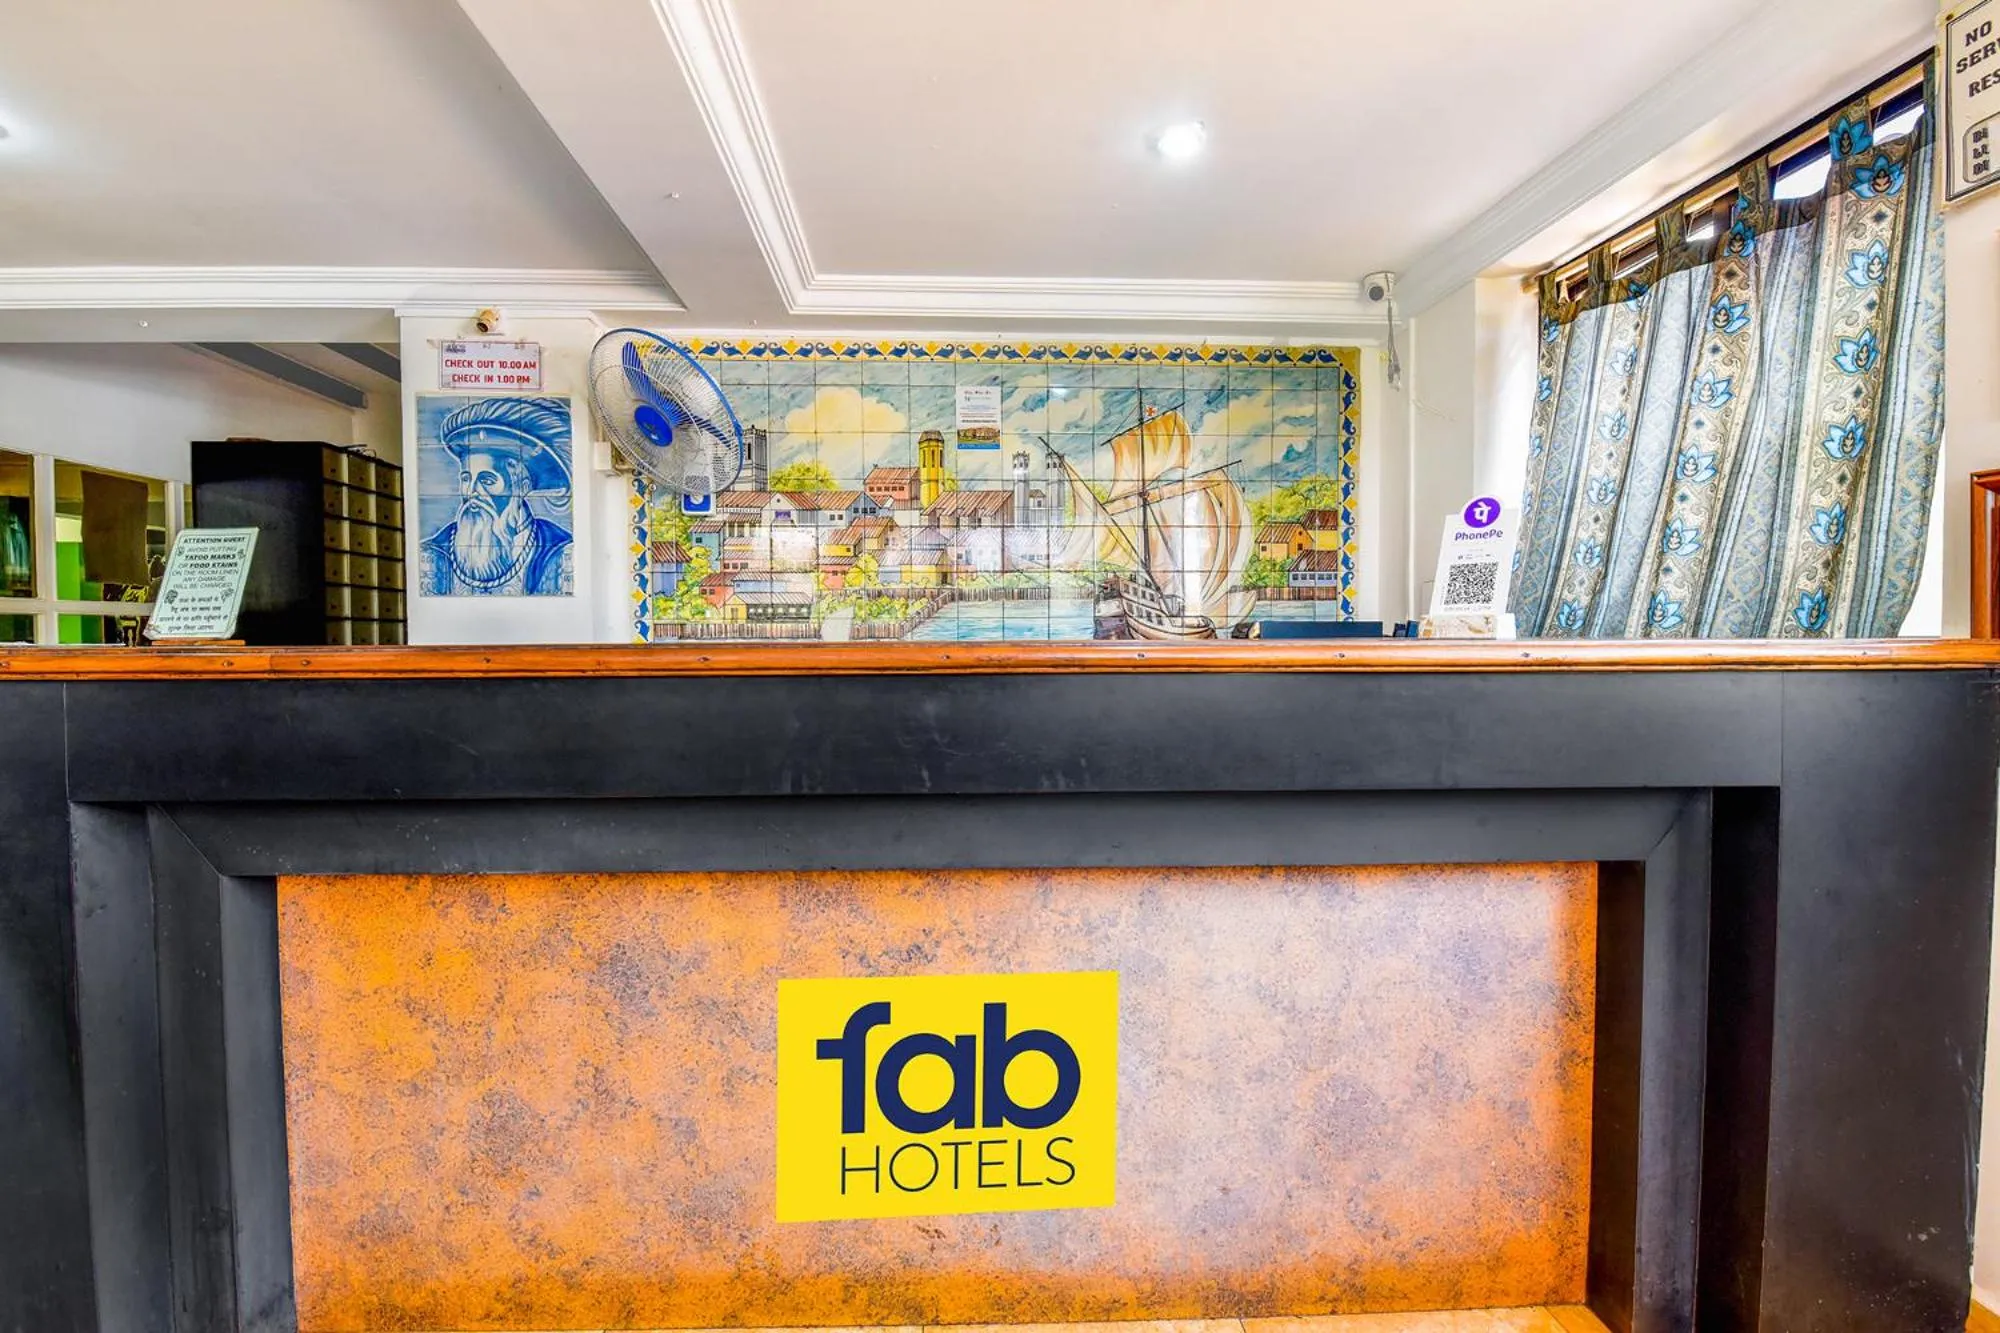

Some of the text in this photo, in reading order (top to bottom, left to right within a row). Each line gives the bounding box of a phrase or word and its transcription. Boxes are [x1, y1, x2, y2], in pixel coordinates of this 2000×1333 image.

[1965, 20, 1992, 47] NO
[1956, 37, 2000, 74] SER
[444, 359, 537, 370] CHECK OUT 10.00 AM
[452, 374, 531, 384] CHECK IN 1.00 PM
[1455, 529, 1503, 541] PhonePe
[816, 1001, 1081, 1134] fab
[840, 1136, 1076, 1196] HOTELS
